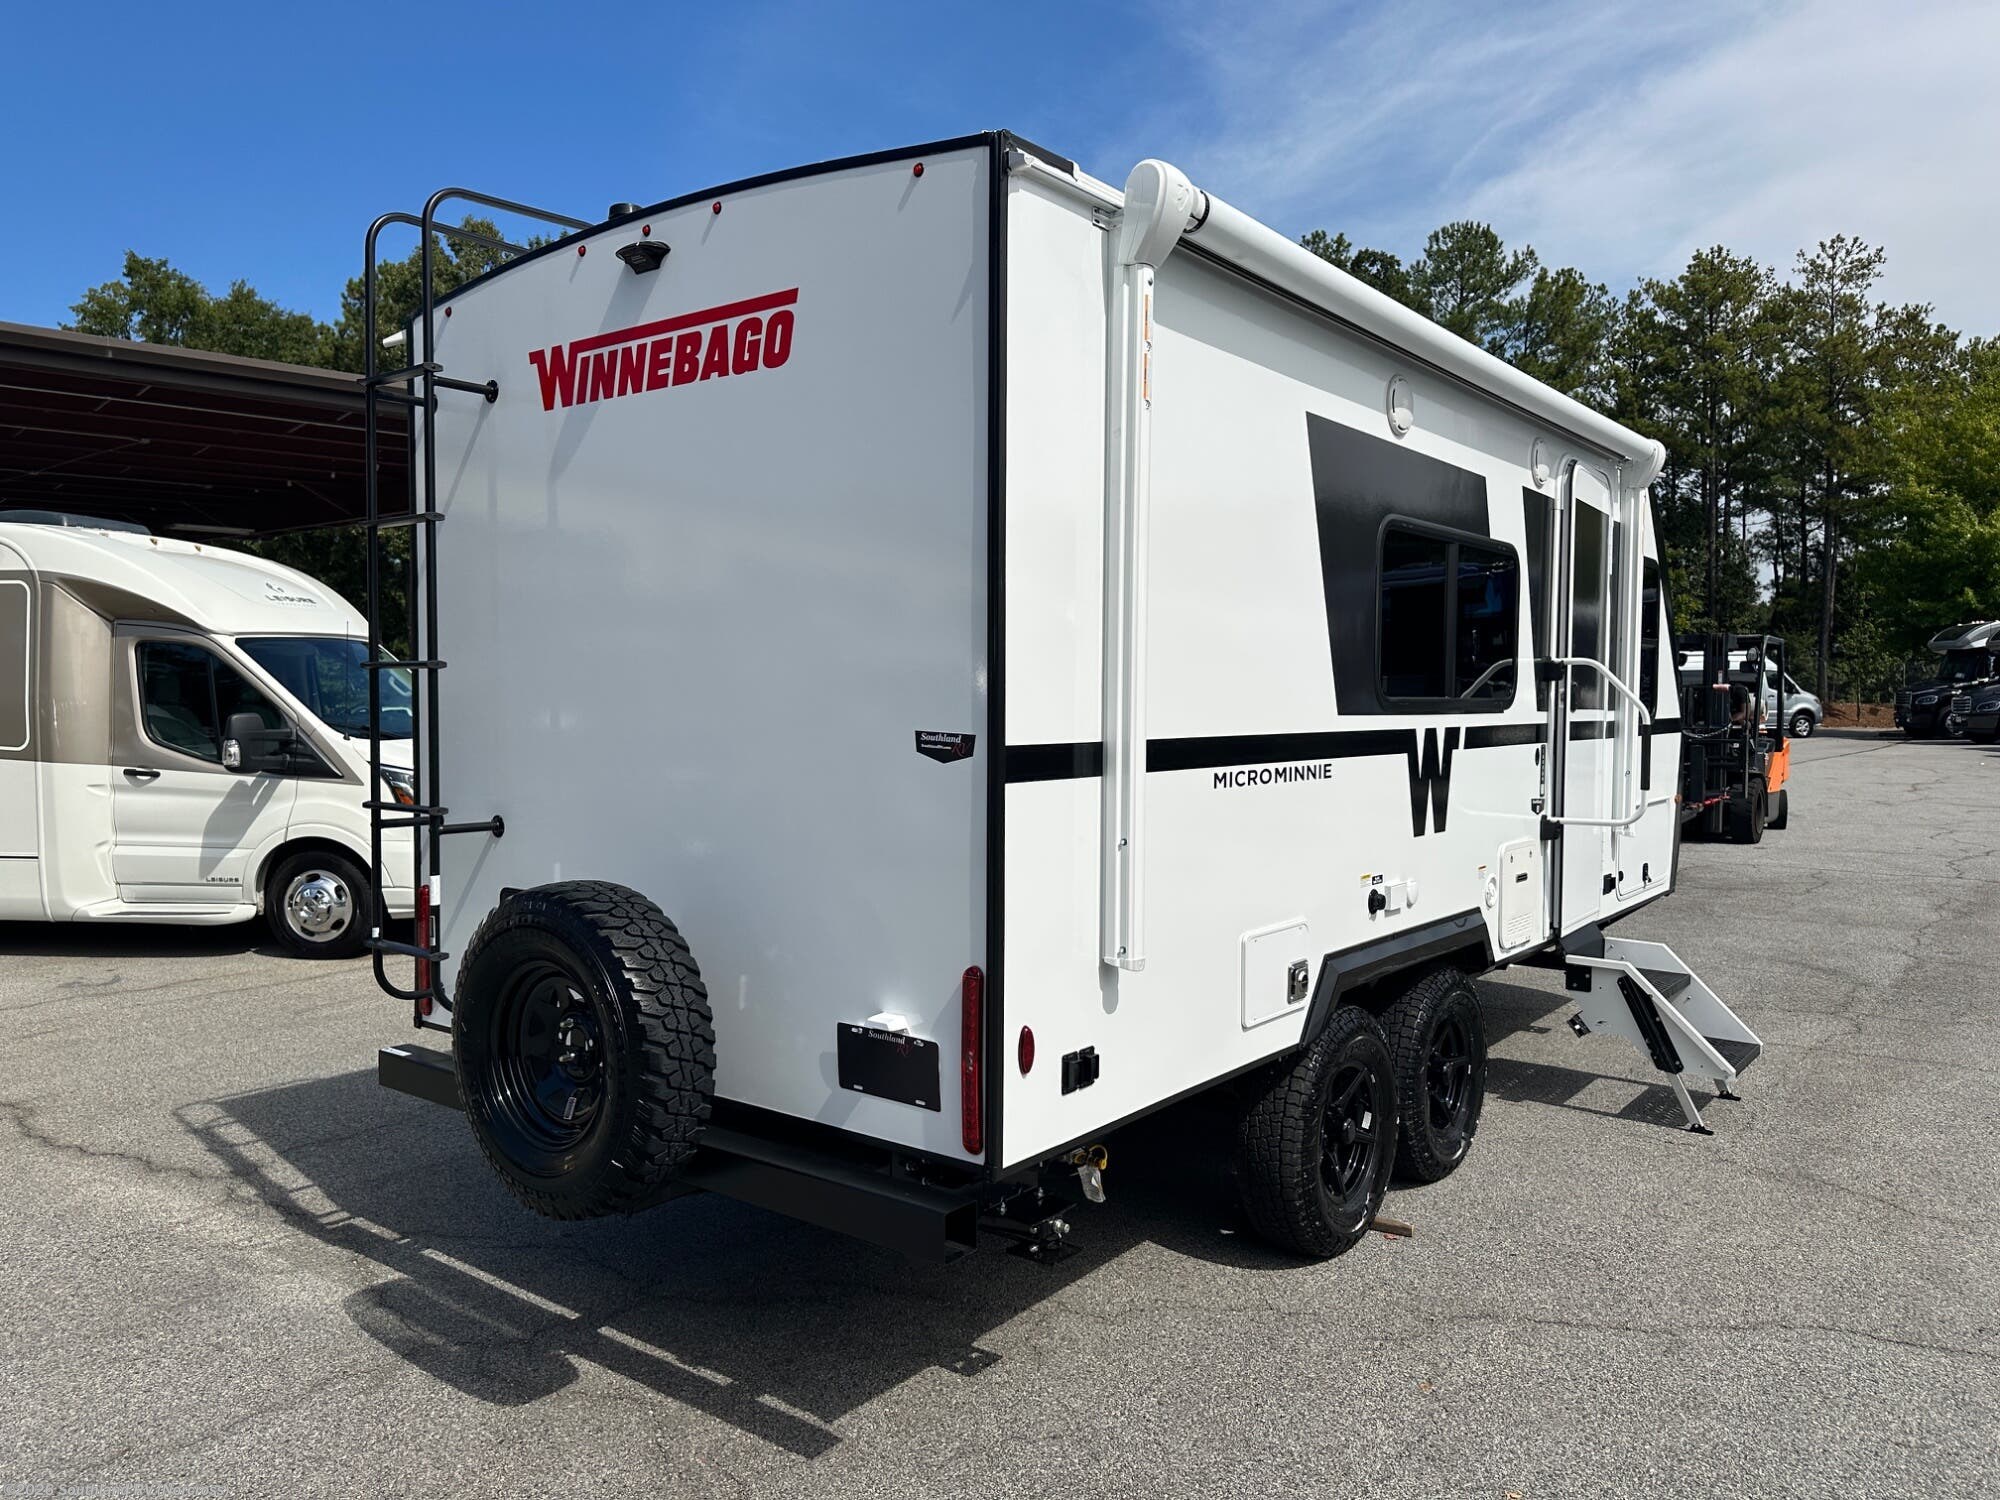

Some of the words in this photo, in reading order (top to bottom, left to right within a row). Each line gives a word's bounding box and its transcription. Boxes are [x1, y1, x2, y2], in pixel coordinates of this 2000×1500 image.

[528, 287, 799, 412] WINNEBAGO
[920, 732, 962, 743] Southland
[1213, 763, 1333, 789] MICROMINNIE
[868, 1030, 906, 1045] Southland
